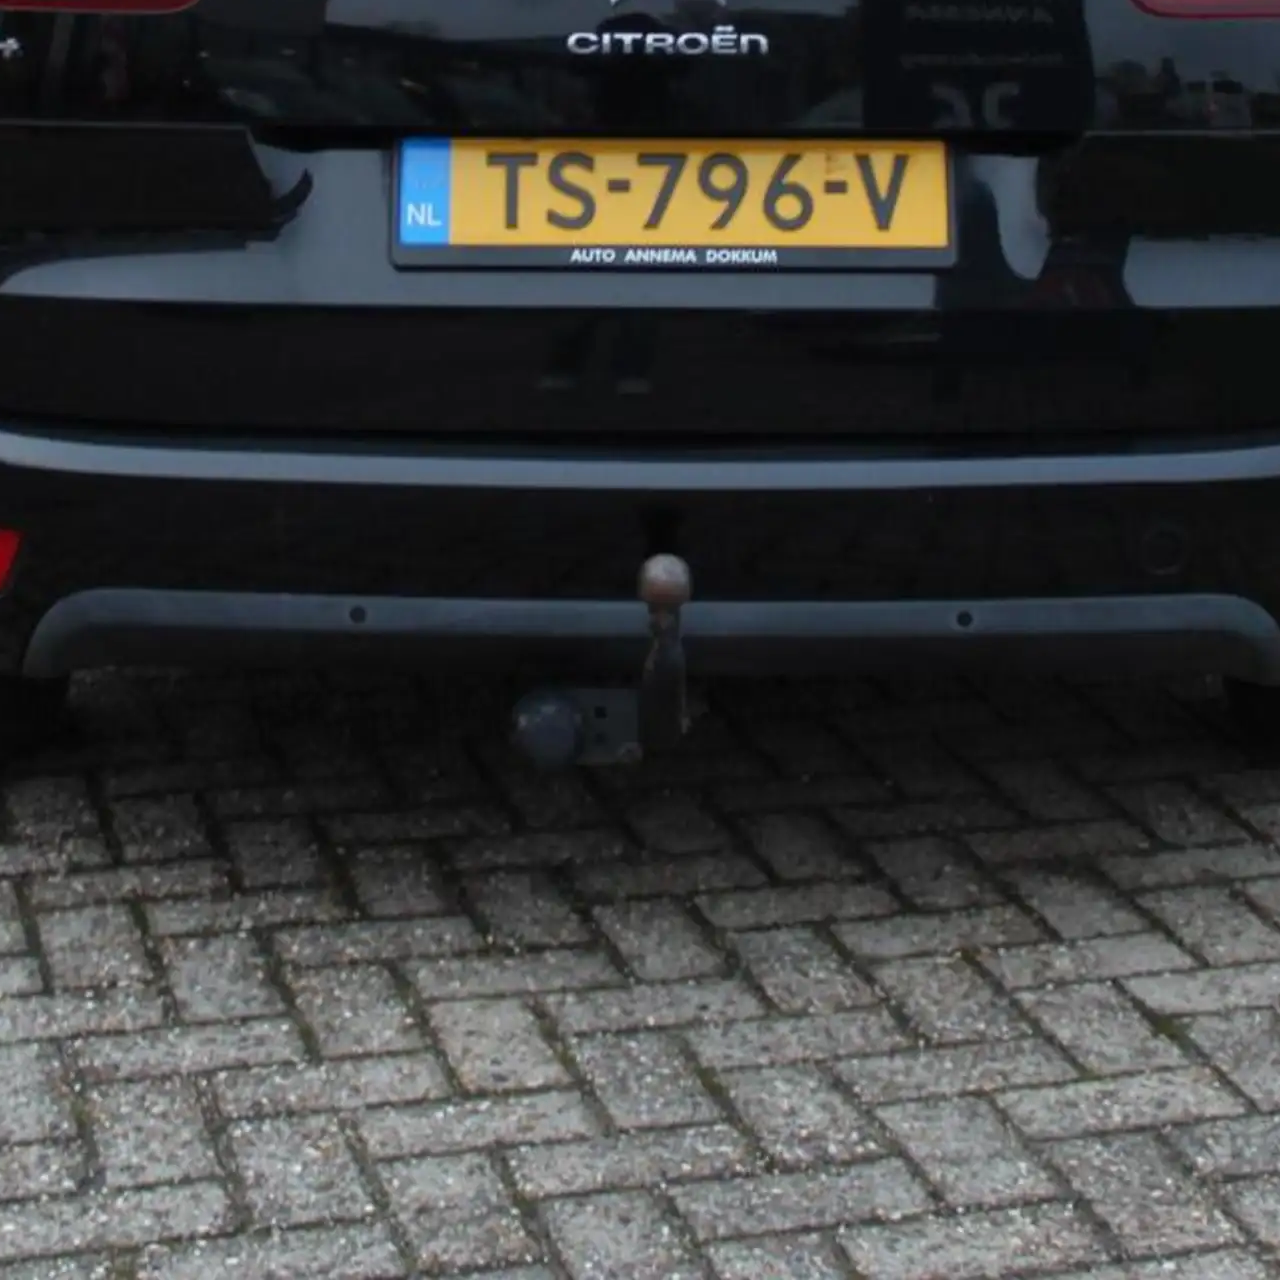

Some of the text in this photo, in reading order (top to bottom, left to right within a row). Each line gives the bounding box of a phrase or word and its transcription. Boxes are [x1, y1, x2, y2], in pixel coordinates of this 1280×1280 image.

[485, 151, 911, 232] TS-796-V
[406, 204, 442, 227] NL
[569, 247, 778, 263] AUTO ANNEMA DOKKUM
